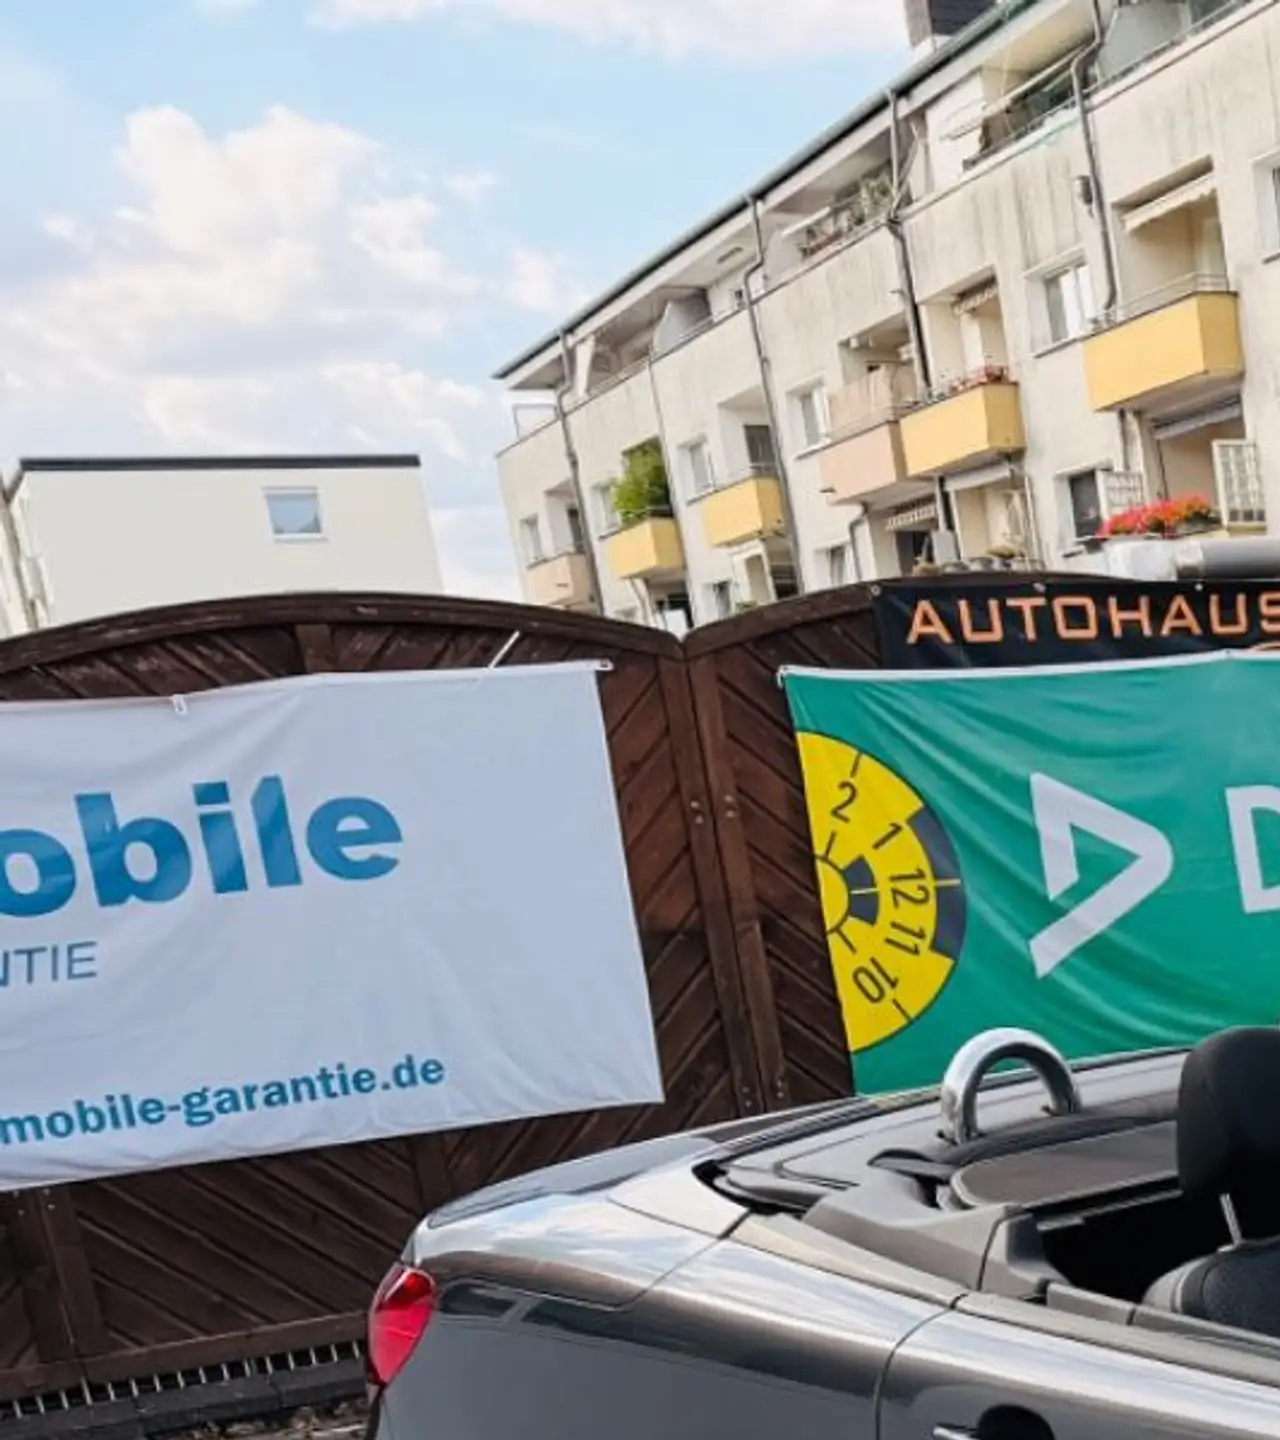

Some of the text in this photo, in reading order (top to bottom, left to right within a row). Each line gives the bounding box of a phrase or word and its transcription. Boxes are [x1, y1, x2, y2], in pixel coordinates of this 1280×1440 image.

[830, 780, 858, 823] 2
[872, 821, 903, 850] 1
[889, 866, 930, 909] 12
[884, 920, 926, 957] 11
[852, 956, 898, 1004] 10
